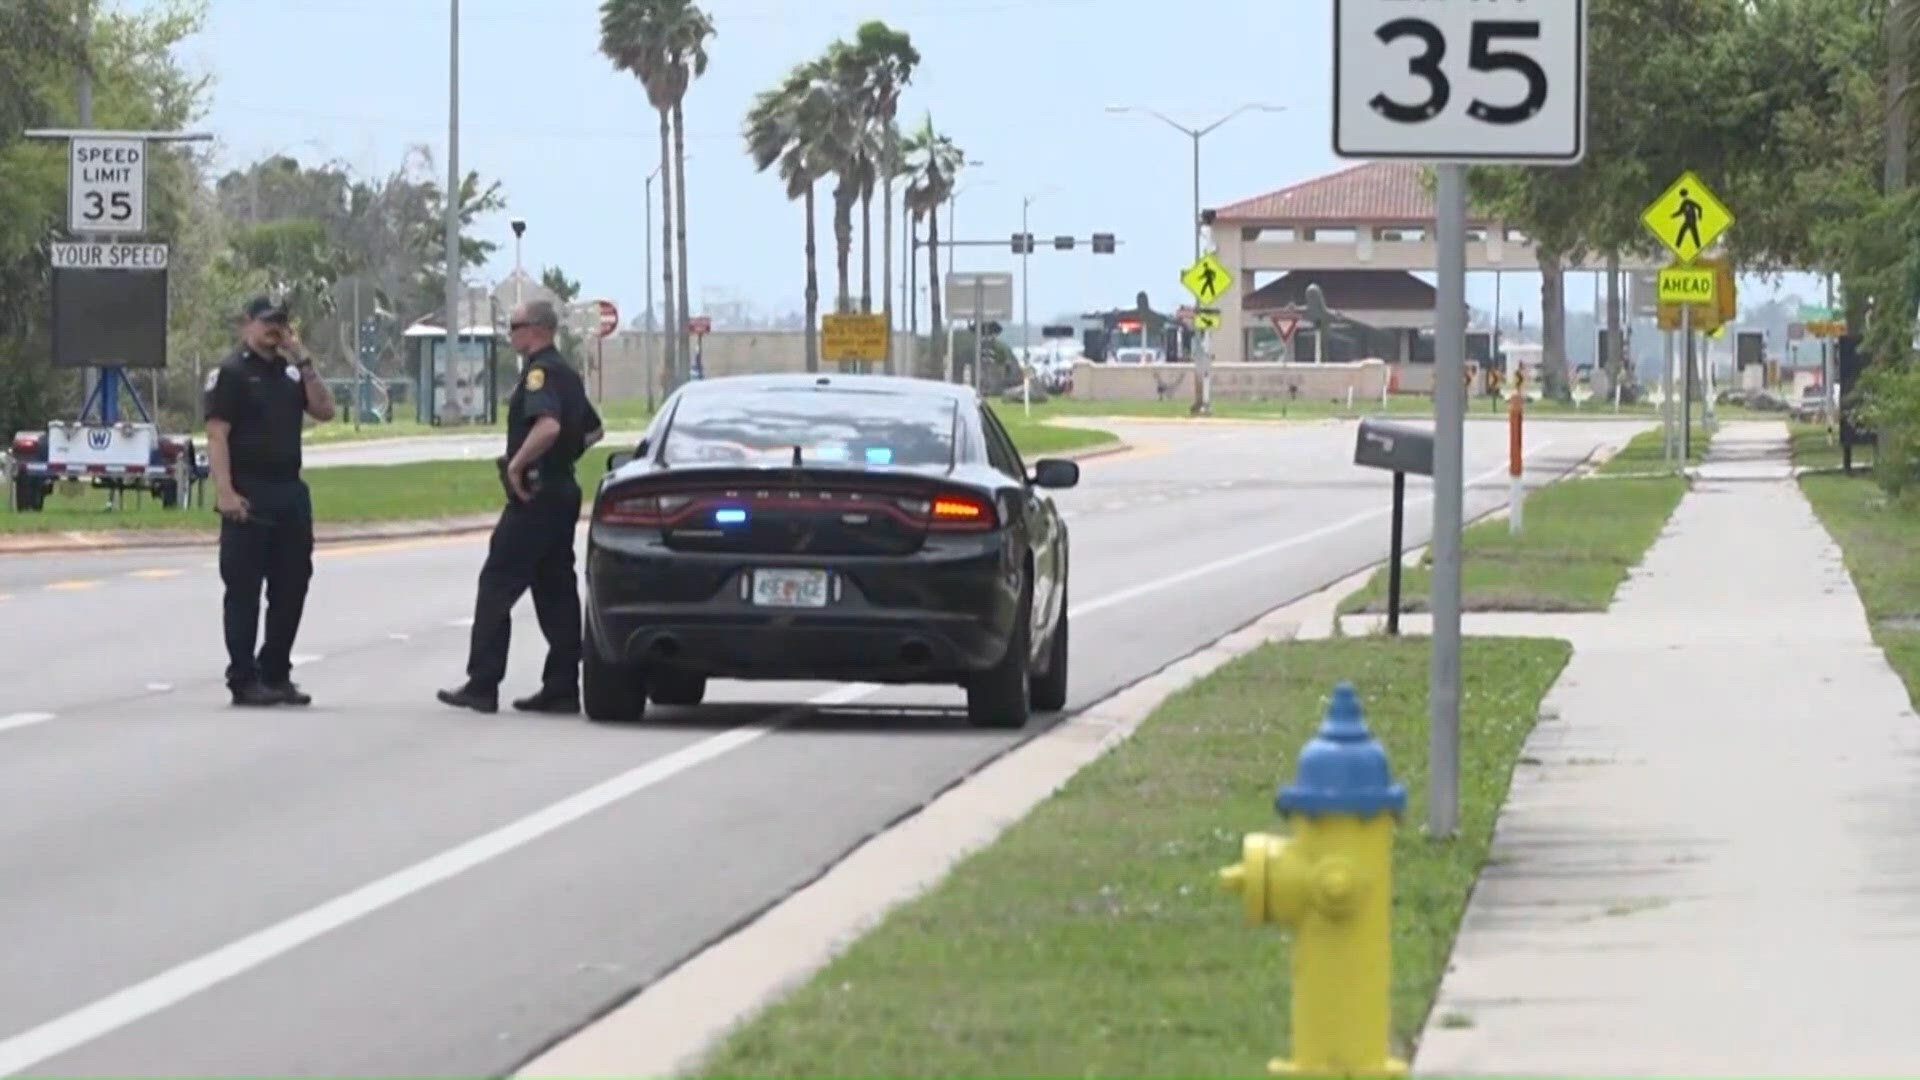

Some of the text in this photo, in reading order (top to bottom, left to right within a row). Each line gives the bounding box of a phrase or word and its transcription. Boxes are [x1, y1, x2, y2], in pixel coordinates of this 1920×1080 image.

[1368, 17, 1548, 125] 35
[77, 148, 139, 164] SPEED
[83, 168, 131, 183] LIMIT
[83, 191, 132, 221] 35
[55, 245, 165, 266] YOUR SPEED
[1662, 276, 1711, 294] AHEAD
